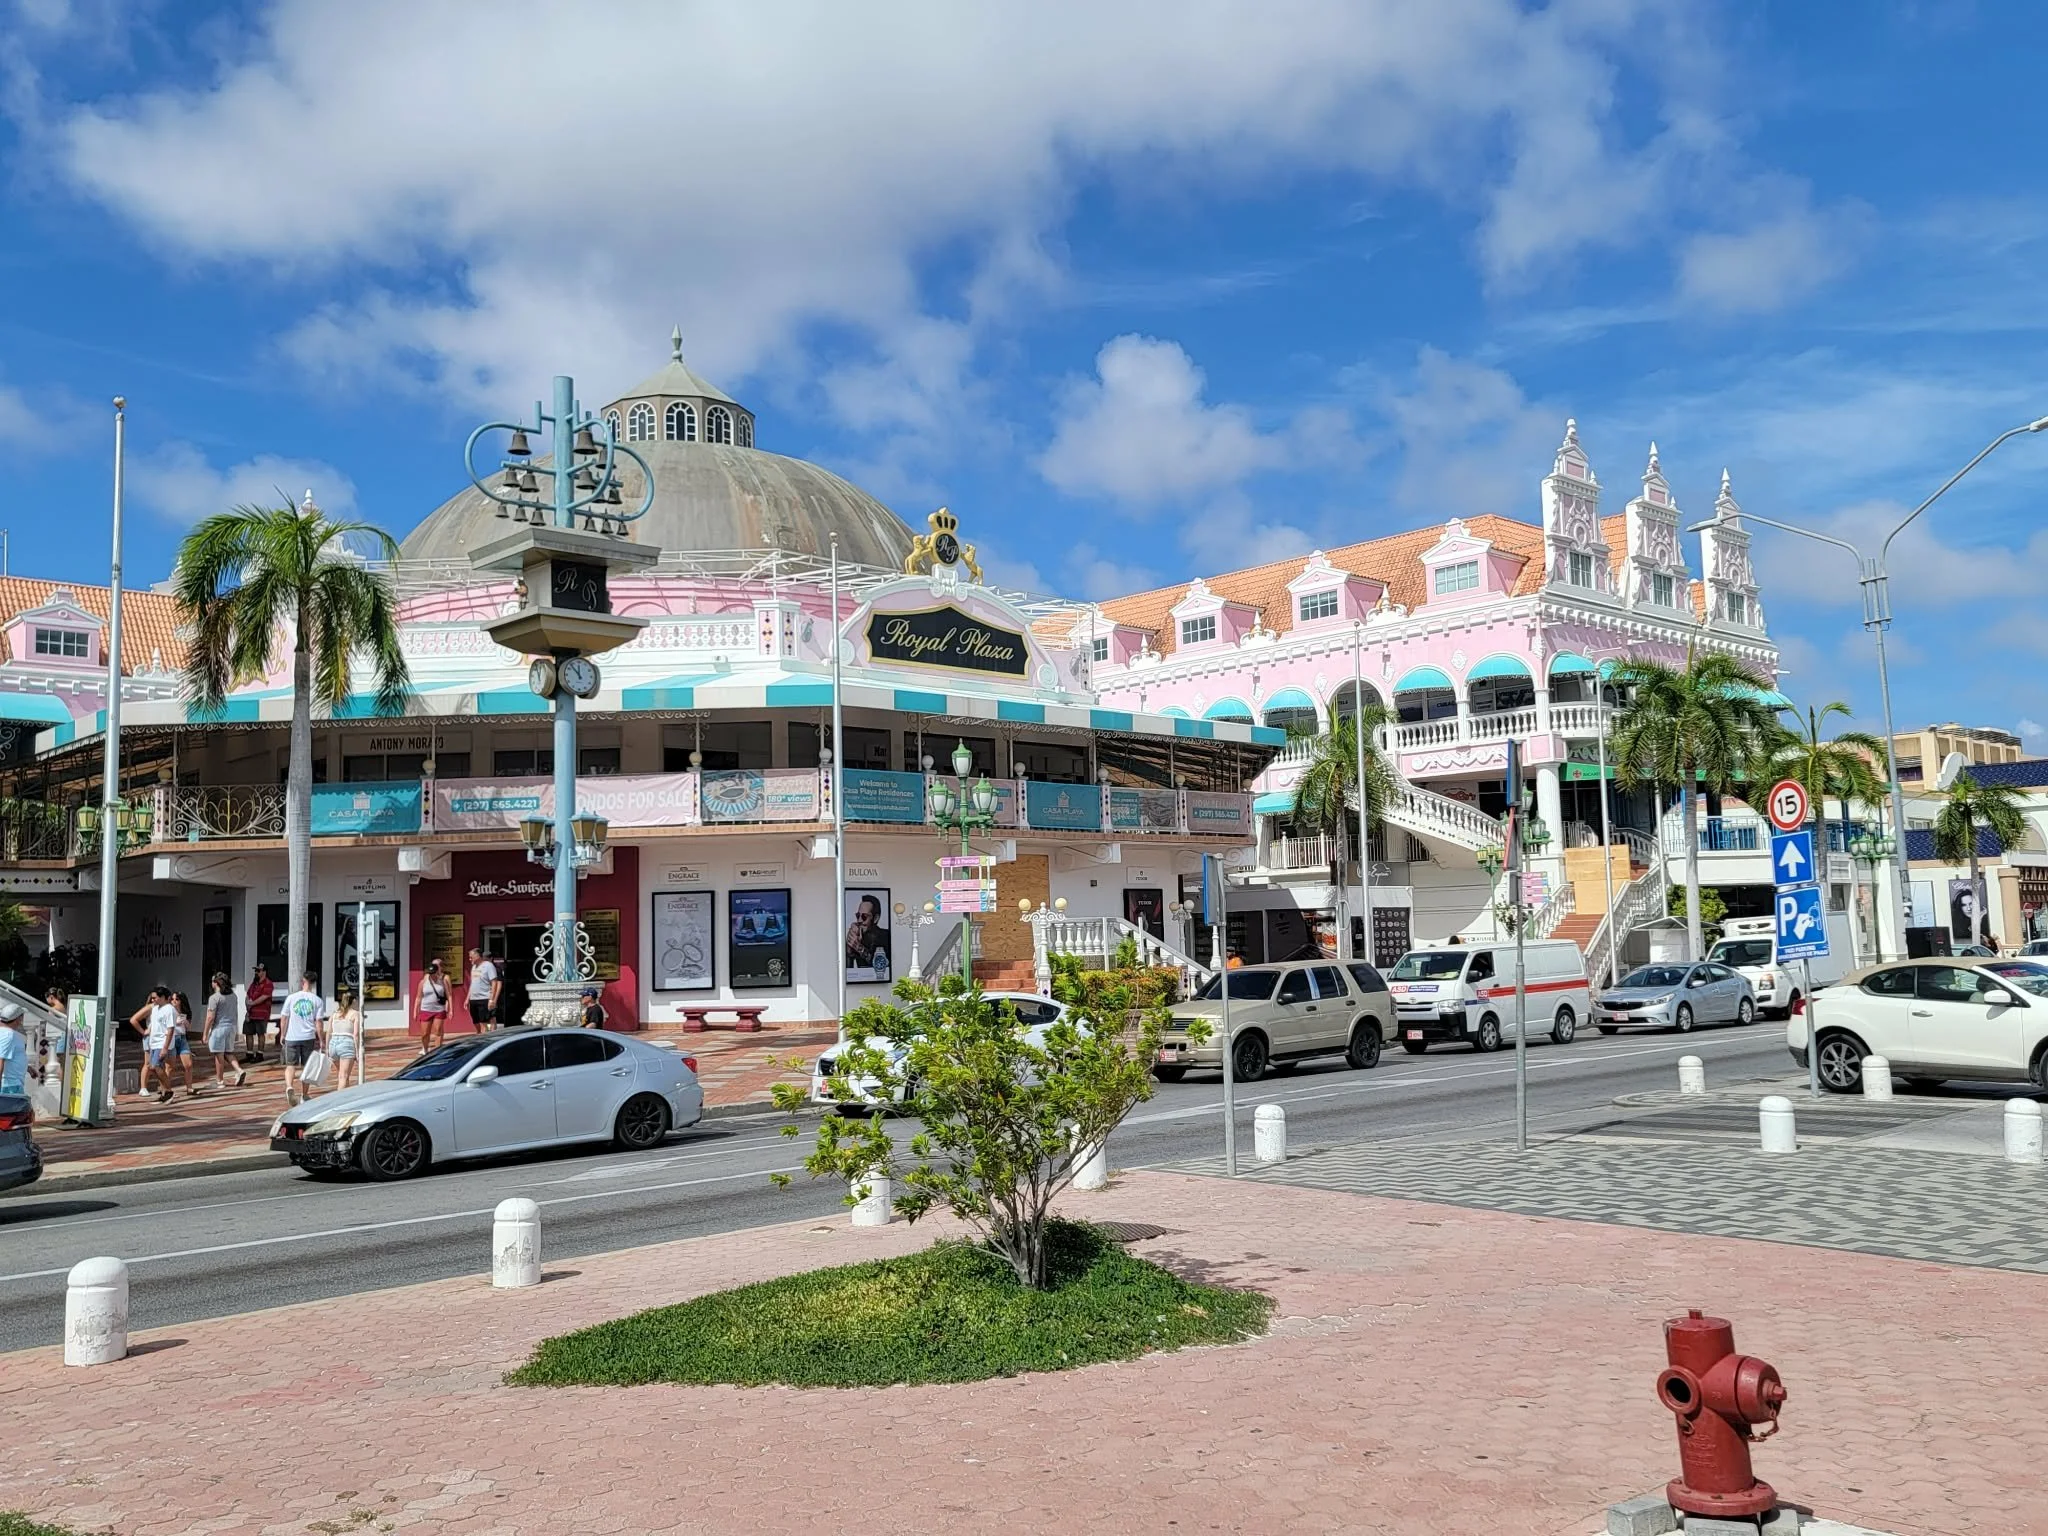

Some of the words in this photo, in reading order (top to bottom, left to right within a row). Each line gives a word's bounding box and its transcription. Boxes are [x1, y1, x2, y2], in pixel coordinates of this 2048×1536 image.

[880, 618, 957, 657] Royal
[956, 627, 1014, 661] Plaza
[370, 738, 404, 751] ANTONY
[859, 779, 889, 788] Welcome
[787, 793, 812, 802] views
[843, 786, 858, 794] Casa
[860, 787, 877, 796] Playa
[878, 789, 914, 797] Residences
[463, 801, 490, 811] (297)
[492, 799, 537, 810] 565.4221
[576, 793, 624, 811] ONDOS
[628, 791, 655, 809] FOR
[658, 788, 690, 808] SALE
[1777, 794, 1798, 817] 15
[329, 810, 358, 818] CASA
[360, 809, 395, 817] PLAYA
[668, 872, 700, 880] ENGRACE
[849, 868, 878, 877] BULOVA
[466, 880, 498, 897] Little
[498, 880, 556, 897] Switzerl
[1779, 896, 1798, 938] P
